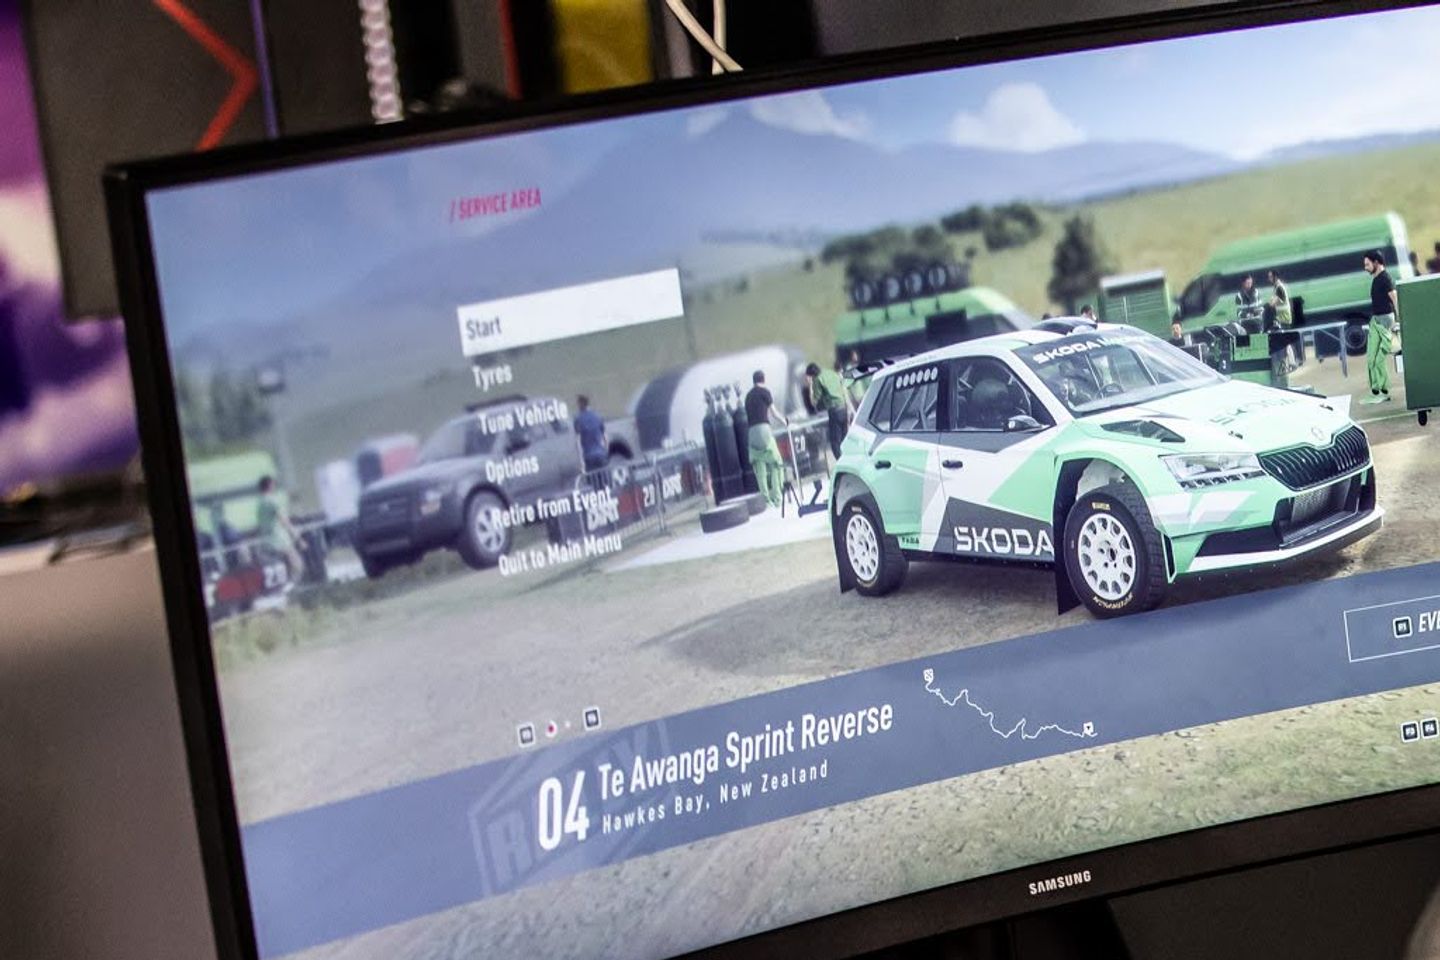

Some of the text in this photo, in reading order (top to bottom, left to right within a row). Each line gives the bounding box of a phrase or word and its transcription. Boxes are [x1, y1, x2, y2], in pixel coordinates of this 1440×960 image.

[458, 191, 507, 220] SERVICE
[510, 187, 542, 211] AREA
[465, 315, 502, 341] Start
[472, 364, 513, 392] Tyres
[479, 399, 569, 436] Tune Vehicle
[485, 454, 540, 484] Options
[491, 486, 612, 531] Retire from Event
[498, 534, 623, 577] Quit to Main Menu
[599, 703, 894, 801] Te Awanga Sprint Reverse
[537, 770, 591, 851] 04
[602, 759, 830, 836] Hawkes Bay, New Zealand
[1029, 869, 1092, 896] SAMSUNG
